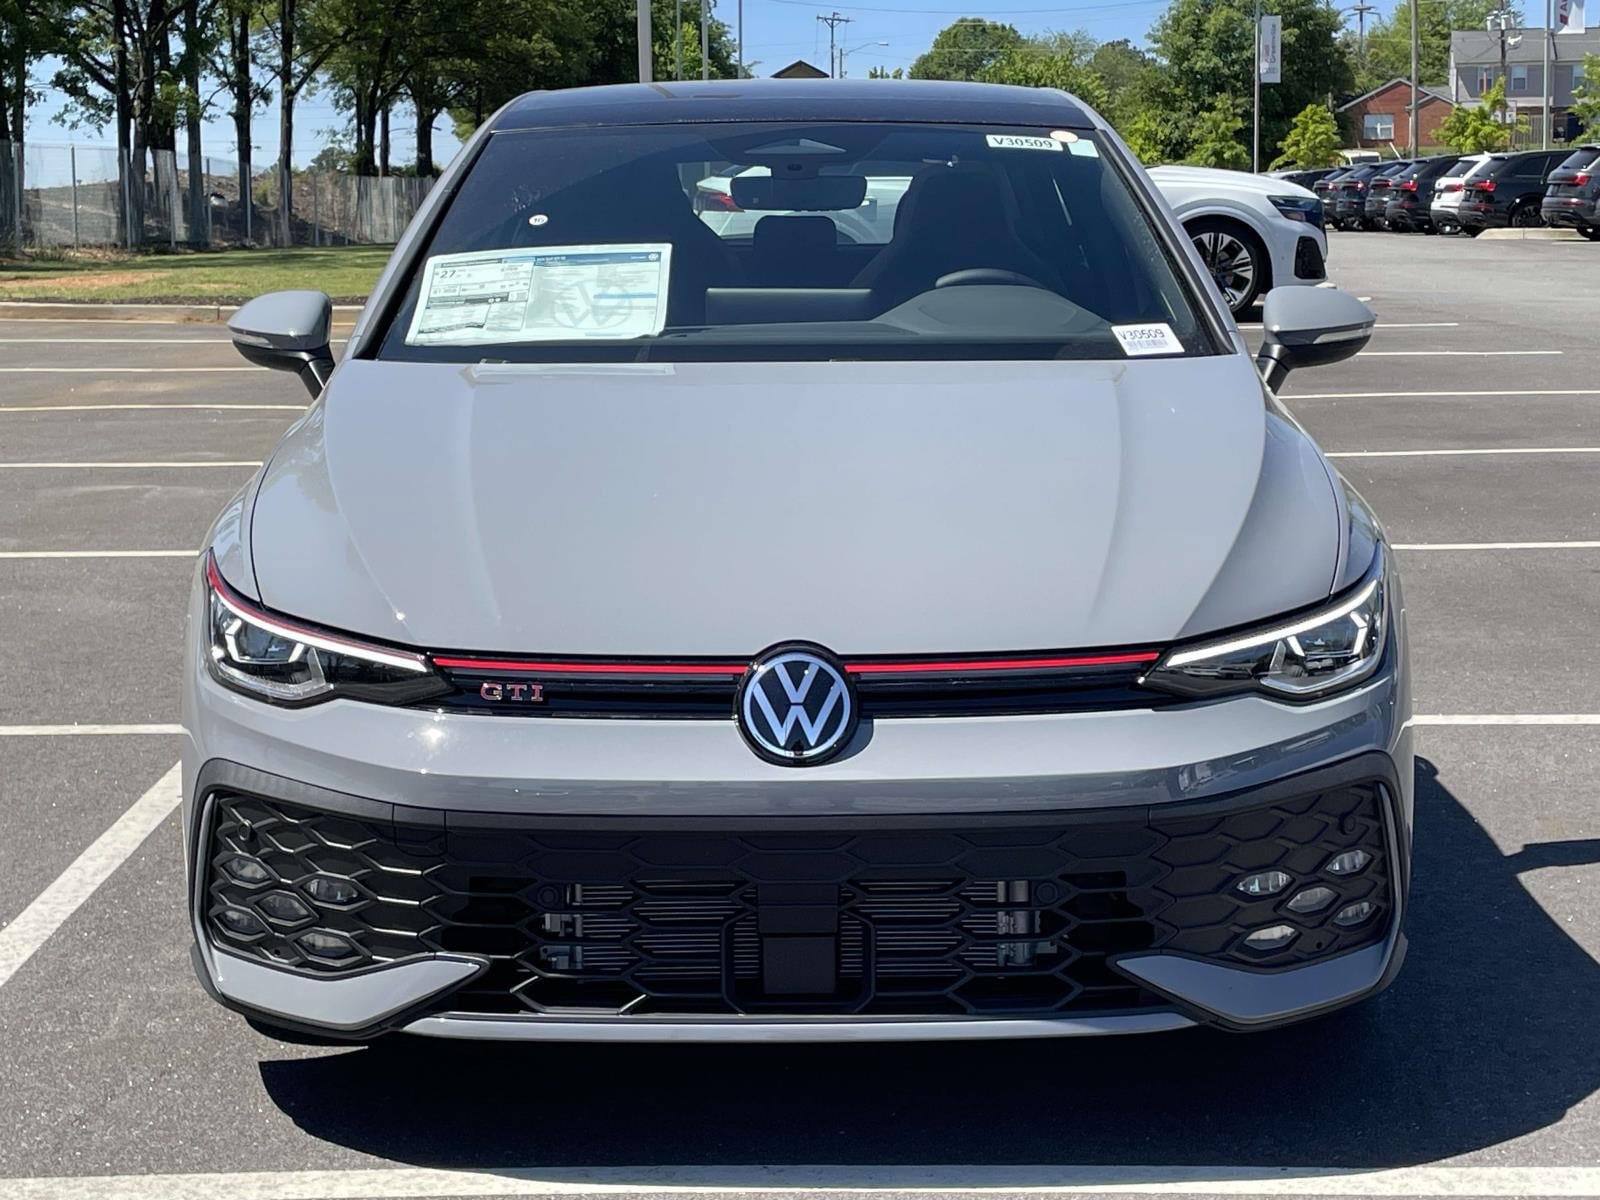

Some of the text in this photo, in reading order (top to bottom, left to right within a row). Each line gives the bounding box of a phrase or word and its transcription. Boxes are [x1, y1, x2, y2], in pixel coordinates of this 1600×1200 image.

[993, 137, 1053, 148] V30509
[439, 269, 457, 279] 27
[1118, 328, 1165, 340] V30509
[480, 683, 543, 702] GTI
[751, 661, 843, 747] VW
